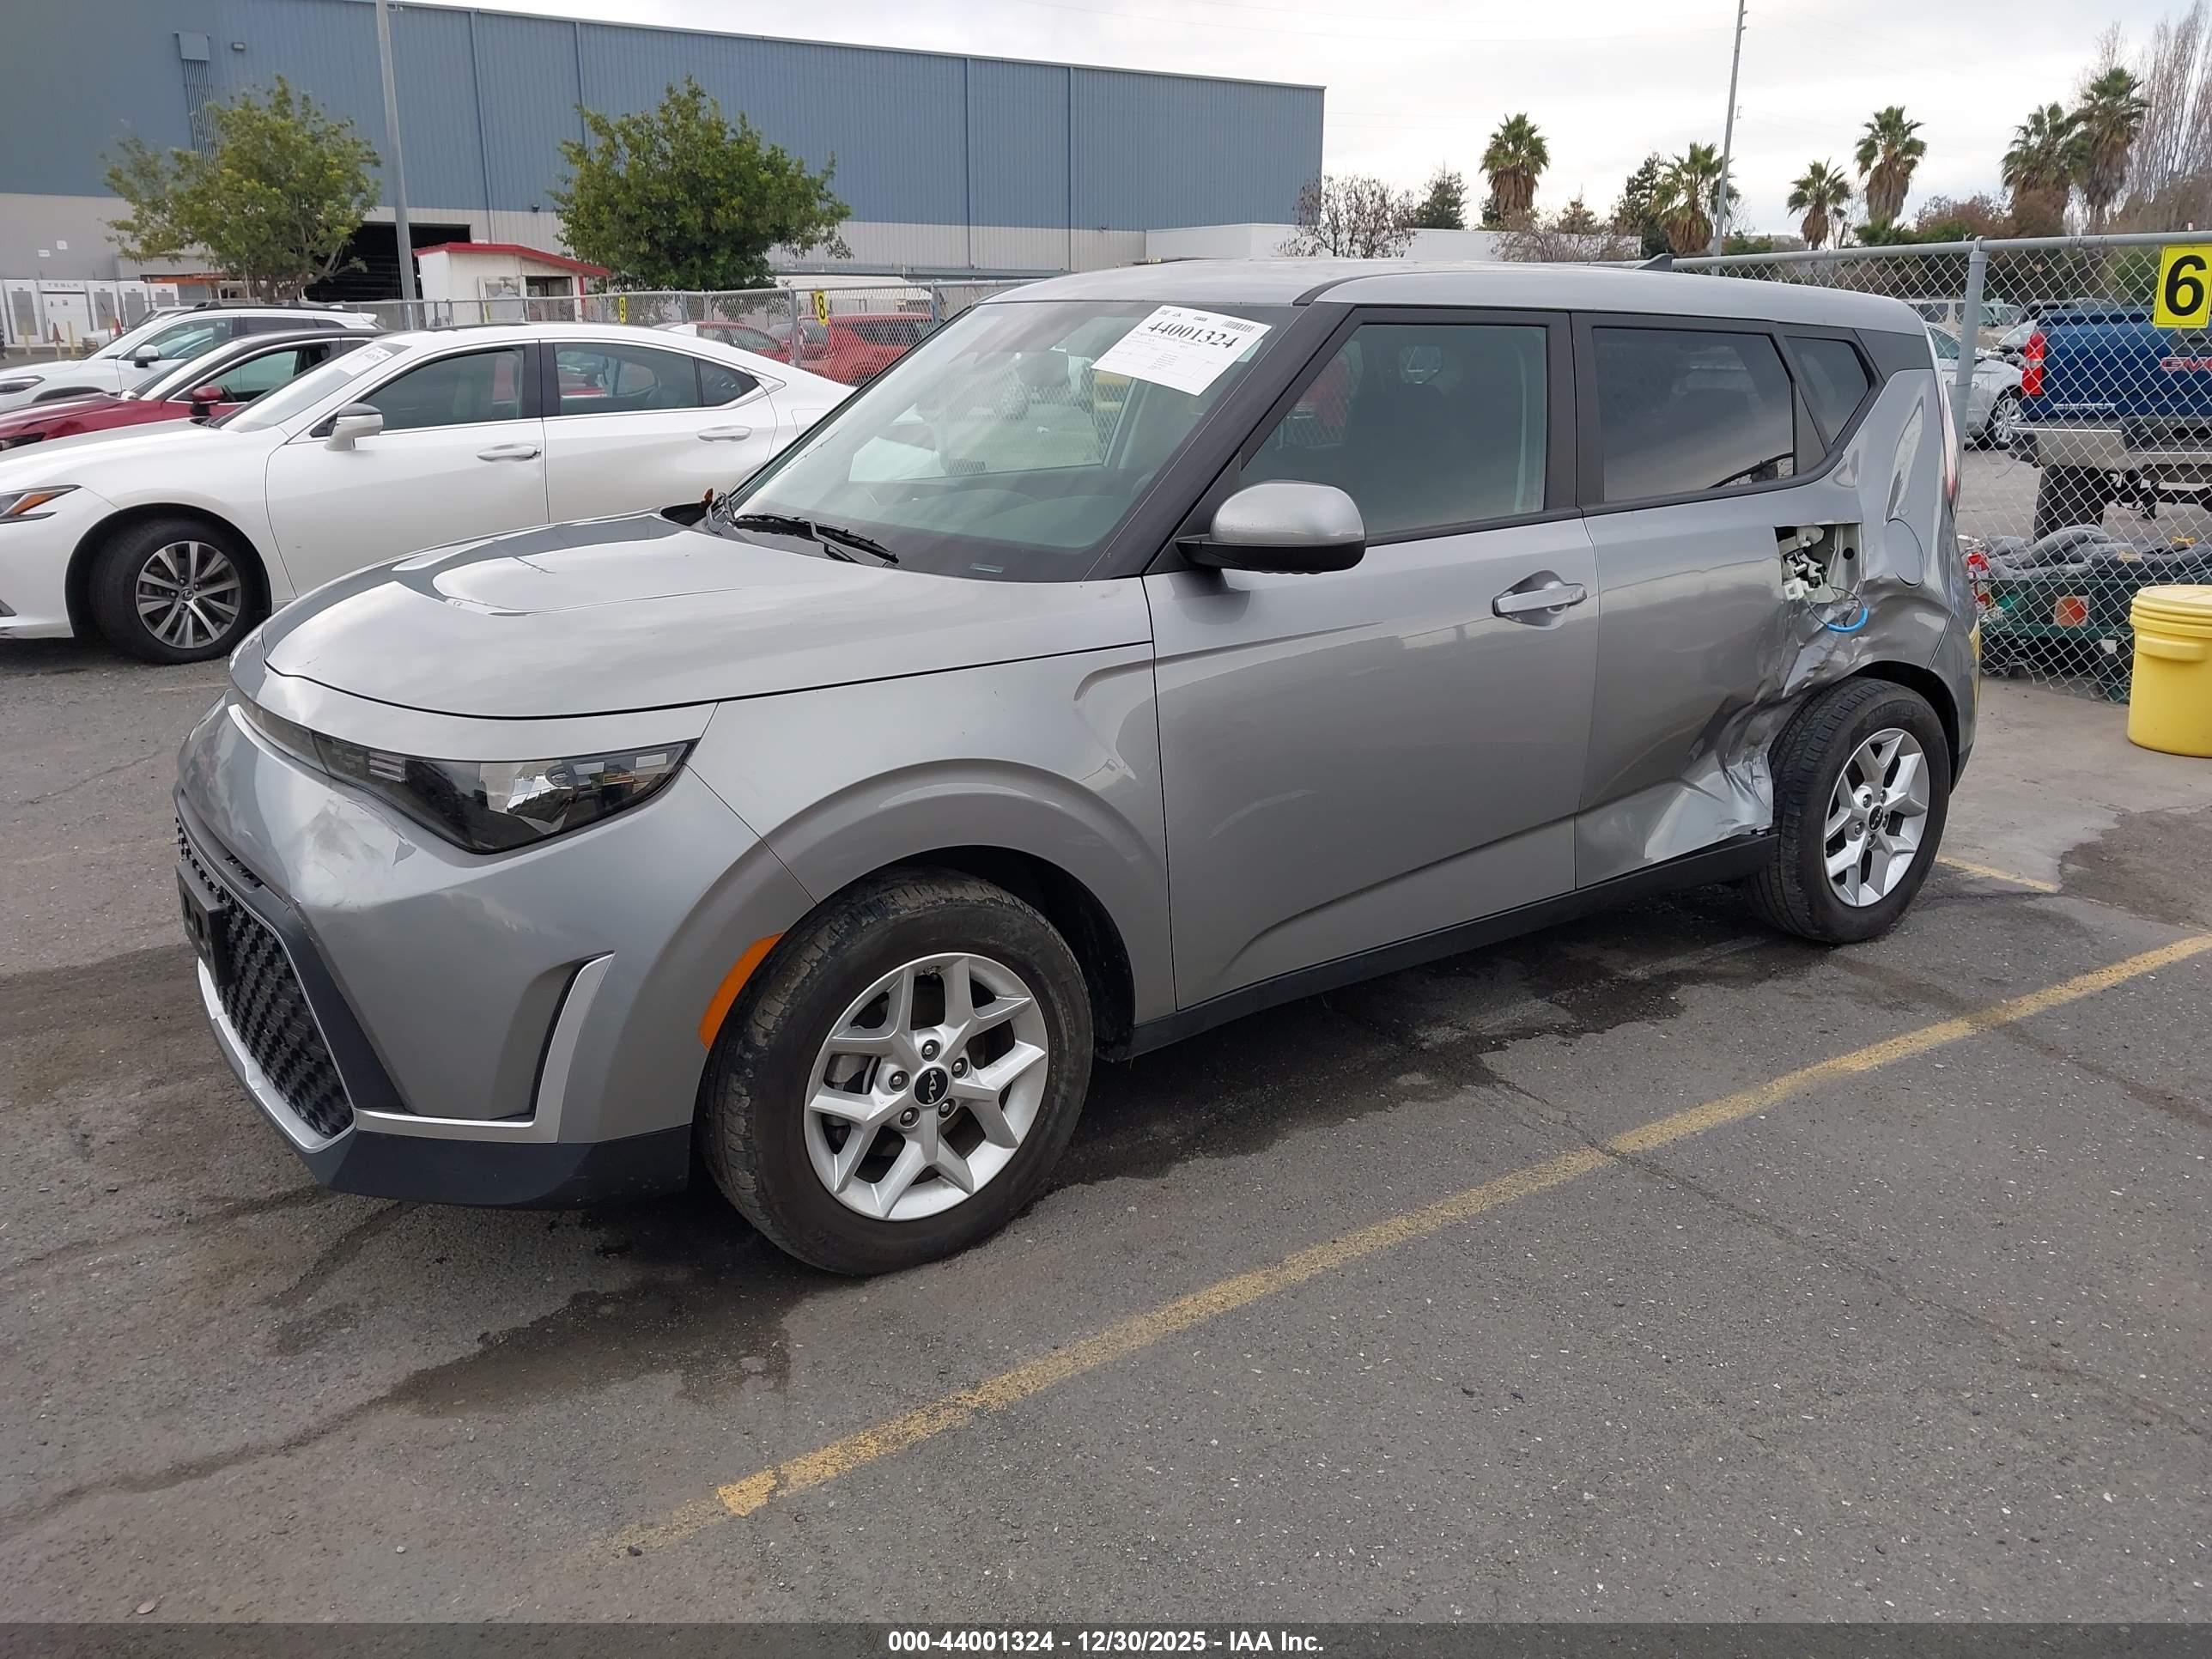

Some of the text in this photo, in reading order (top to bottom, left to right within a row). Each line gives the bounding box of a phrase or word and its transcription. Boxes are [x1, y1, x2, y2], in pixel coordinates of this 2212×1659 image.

[2165, 254, 2208, 317] 6
[620, 299, 625, 319] 9
[817, 295, 826, 320] 8
[1147, 321, 1240, 349] 44001324
